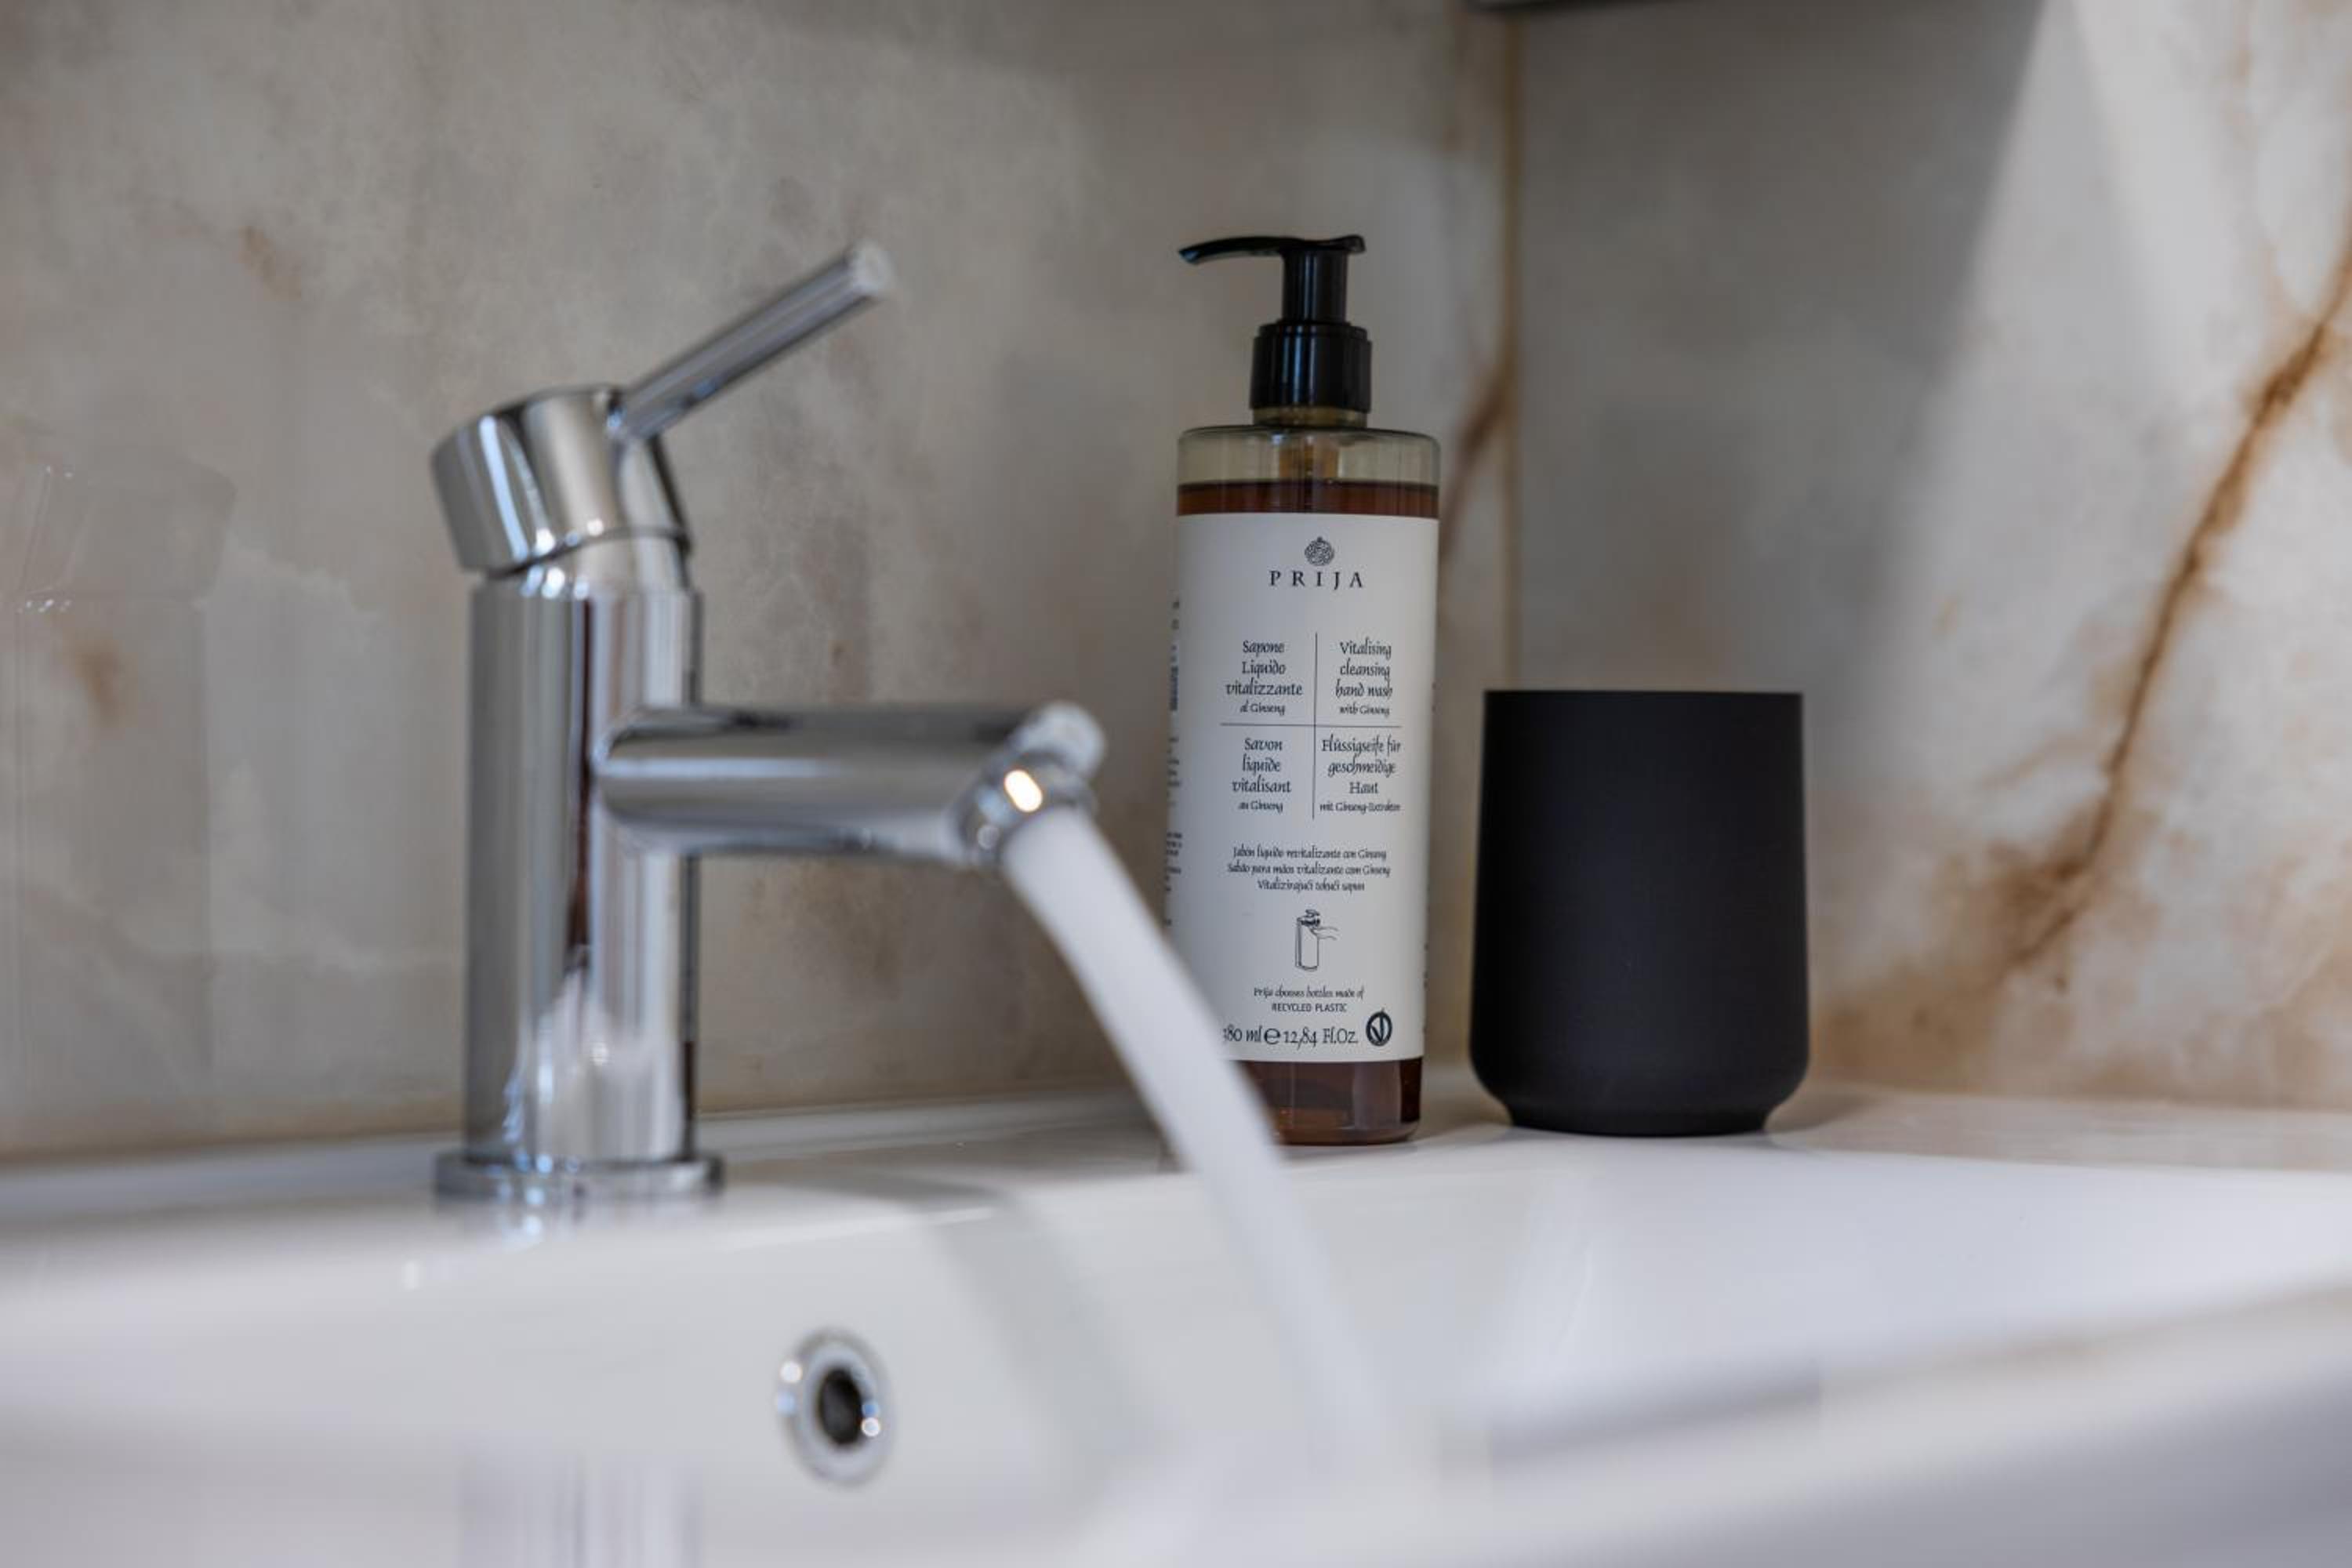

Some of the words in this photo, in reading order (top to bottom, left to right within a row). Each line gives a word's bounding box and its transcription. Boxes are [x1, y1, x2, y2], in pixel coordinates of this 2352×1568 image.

[1269, 569, 1363, 590] PRIJA
[1242, 639, 1285, 657] Sapone
[1339, 637, 1392, 659] Vitalising
[1241, 659, 1287, 678] Liquido
[1340, 657, 1391, 681] cleansing
[1225, 677, 1303, 695] vitalizzante
[1335, 678, 1364, 697] hand
[1367, 677, 1392, 699] wash
[1250, 702, 1286, 715] Ginseng
[1339, 702, 1358, 714] with
[1359, 705, 1390, 717] Ginseng
[1244, 737, 1283, 751] Savon
[1243, 753, 1280, 775] liquide
[1327, 753, 1396, 778] geschmeidige
[1232, 774, 1291, 793] vitalisant
[1349, 782, 1379, 794] Haut
[1250, 799, 1283, 813] Ginseng
[1319, 801, 1334, 811] mit
[1358, 848, 1387, 862] Ginseng
[1251, 865, 1271, 876] para
[1296, 861, 1344, 874] vitalizante
[1363, 864, 1391, 877] Ginseng
[1254, 986, 1273, 999] Prija
[1275, 983, 1305, 998] chooses
[1306, 985, 1333, 998] bottles
[1335, 988, 1356, 997] made
[1272, 1003, 1312, 1012] RECYCLED
[1315, 1003, 1347, 1012] PLASTIC
[1246, 1025, 1263, 1043] ml
[1283, 1026, 1318, 1051] 12,84
